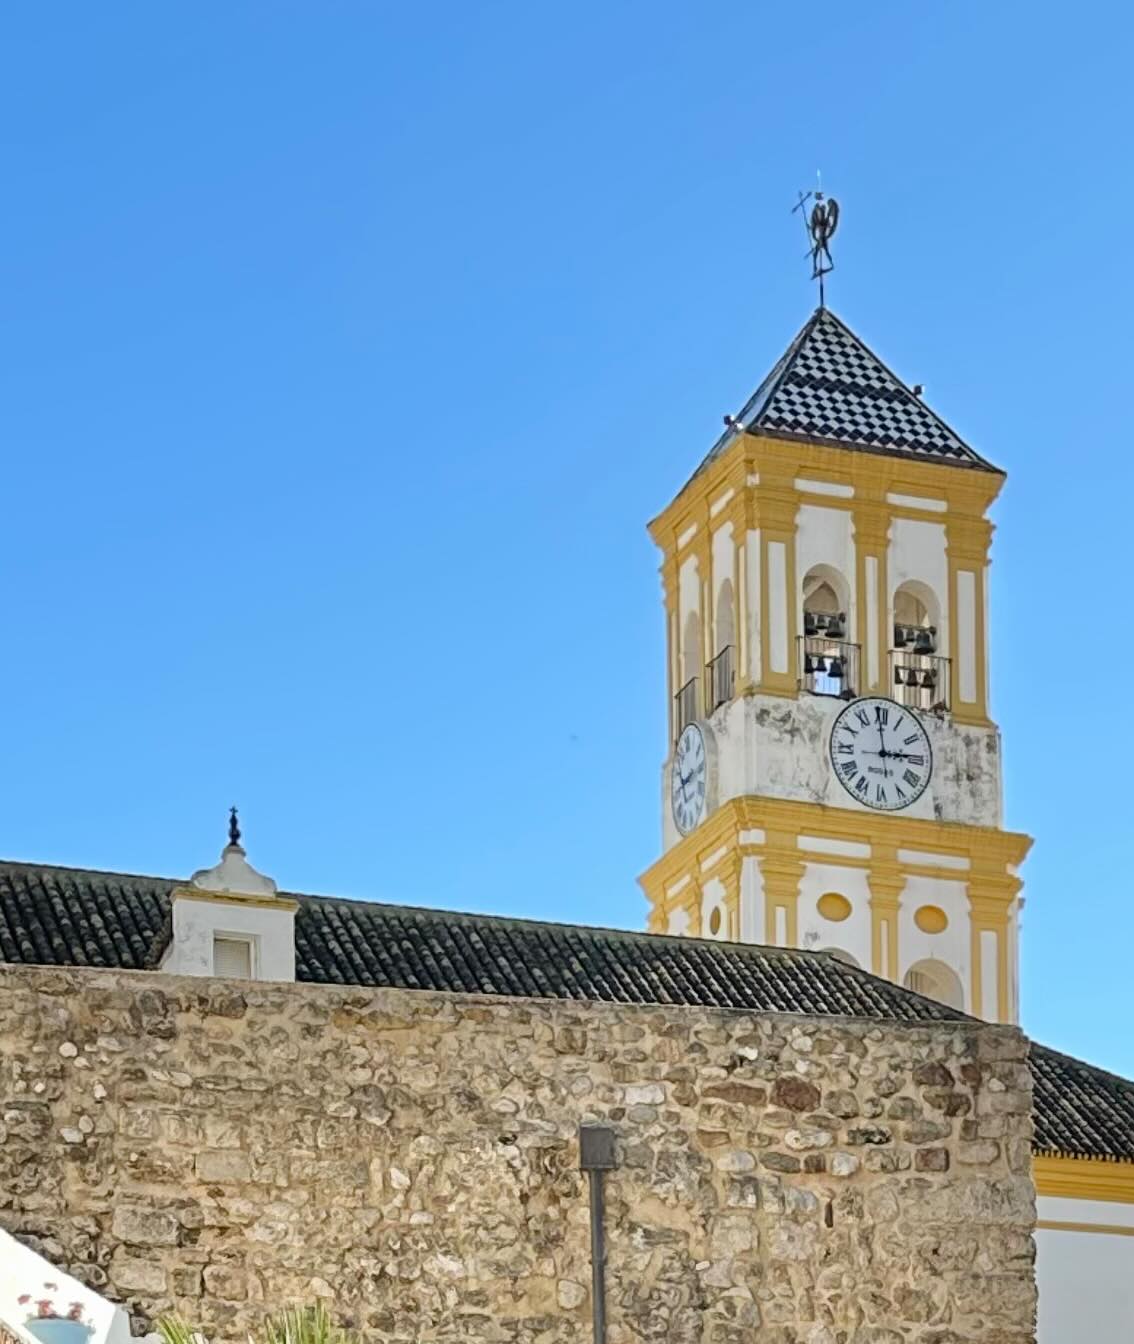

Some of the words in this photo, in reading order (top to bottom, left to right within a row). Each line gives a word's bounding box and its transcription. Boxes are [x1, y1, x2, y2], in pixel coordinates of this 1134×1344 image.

[854, 708, 870, 728] XI
[893, 716, 904, 731] I
[841, 722, 859, 738] X
[904, 733, 920, 745] II
[838, 741, 854, 755] IX
[876, 784, 887, 802] VI
[895, 783, 906, 798] V
